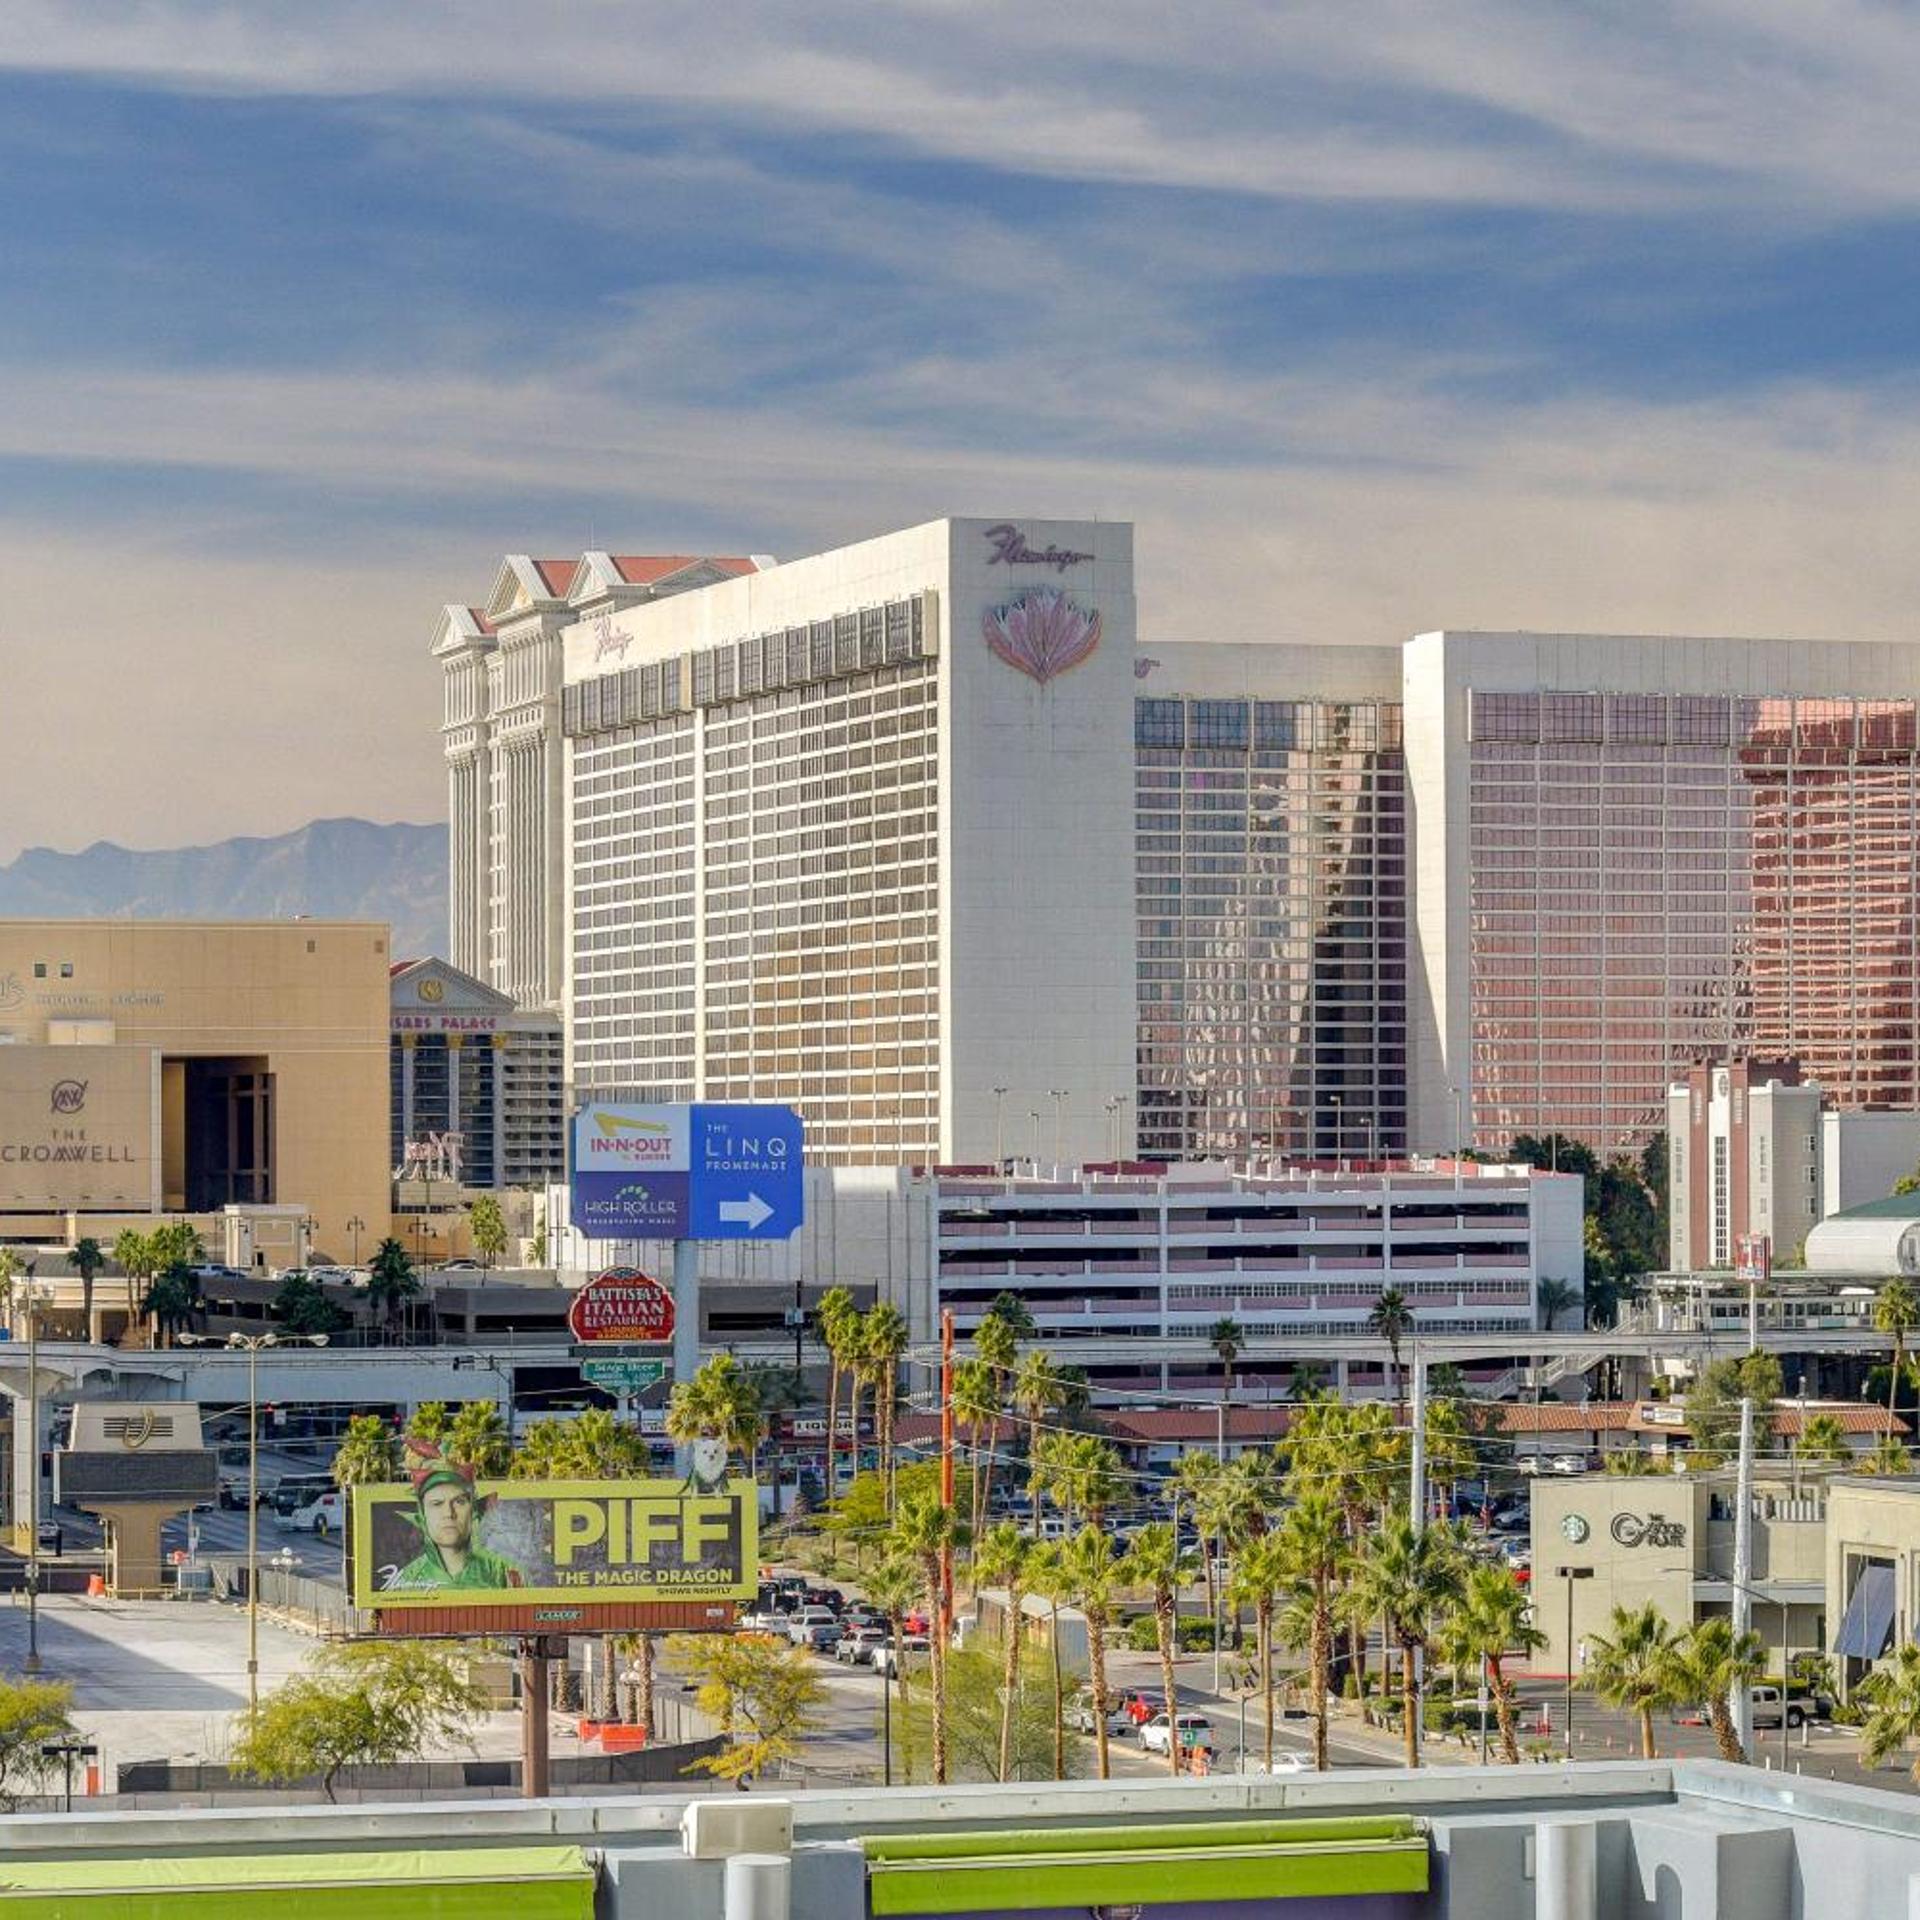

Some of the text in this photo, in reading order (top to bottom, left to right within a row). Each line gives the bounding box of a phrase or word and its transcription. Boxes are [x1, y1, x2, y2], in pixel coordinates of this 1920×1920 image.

[53, 1129, 86, 1140] THE
[706, 1124, 728, 1134] THE
[1, 1145, 135, 1162] CROMWELL
[706, 1137, 786, 1157] LINQ
[706, 1161, 786, 1171] PROMENADE
[585, 1201, 677, 1217] HIGH ROLLER
[588, 1287, 661, 1300] BATTISTA'S
[584, 1301, 664, 1316] ITALIAN
[584, 1316, 664, 1328] RESTAURANT
[554, 1499, 732, 1565] PIFF
[555, 1567, 732, 1585] THE MAGIC DRAGON
[693, 1585, 731, 1595] NIGHTLY
